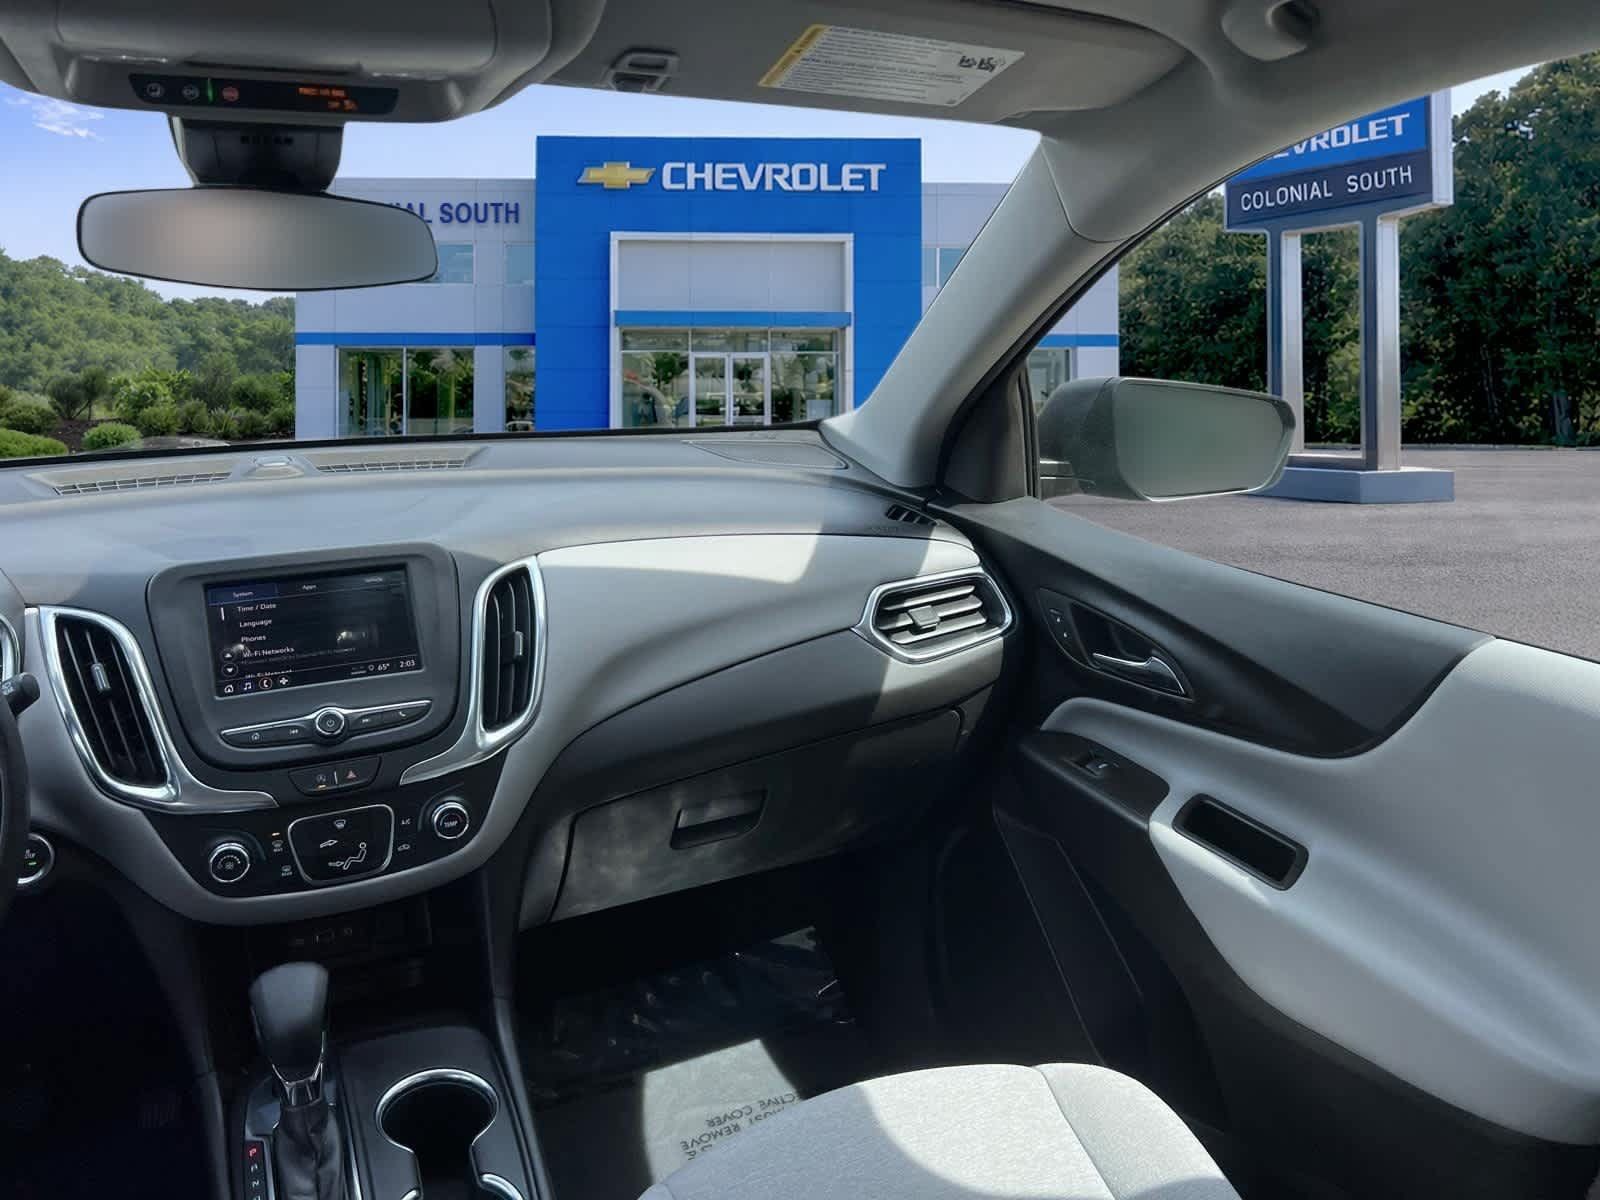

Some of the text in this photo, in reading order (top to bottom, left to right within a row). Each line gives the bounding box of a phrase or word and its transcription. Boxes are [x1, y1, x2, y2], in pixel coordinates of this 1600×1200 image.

[662, 162, 887, 192] CHEVROLET
[1241, 165, 1412, 211] COLONIAL SOUTH
[439, 202, 520, 224] SOUTH
[237, 605, 254, 613] Time
[239, 618, 273, 629] Language
[241, 634, 267, 643] Phones
[262, 646, 295, 656] Networks
[400, 659, 416, 668] 2:03
[706, 1105, 753, 1127] COVER
[680, 1123, 741, 1151] REMOVE
